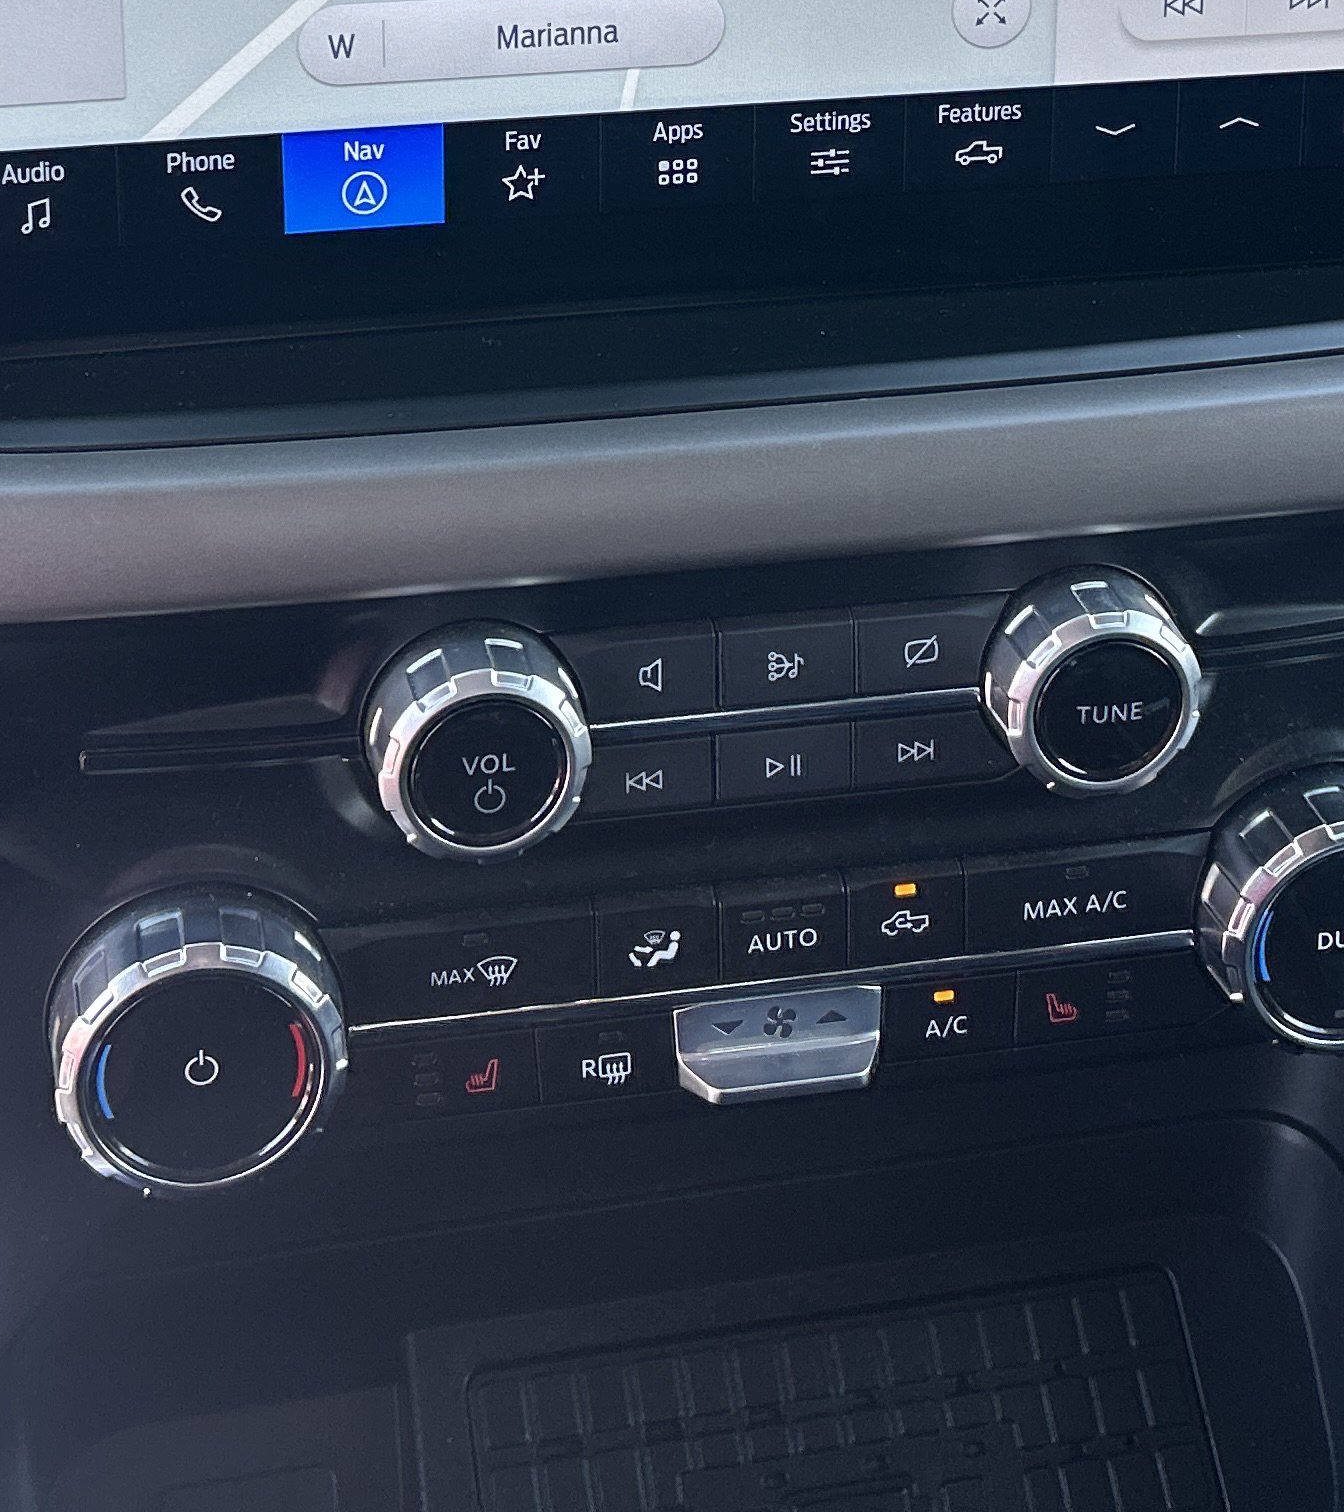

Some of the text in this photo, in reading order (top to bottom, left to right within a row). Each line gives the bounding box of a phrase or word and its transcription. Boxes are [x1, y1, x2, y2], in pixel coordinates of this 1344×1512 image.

[329, 33, 355, 59] W
[497, 19, 619, 50] Marianna
[790, 110, 871, 137] Settings
[937, 100, 1022, 125] Features
[504, 129, 542, 152] Fav
[653, 119, 704, 145] Apps
[166, 149, 236, 175] Phone
[343, 140, 385, 162] Nav
[1, 161, 65, 184] Audio
[1076, 700, 1144, 725] TUNE
[462, 753, 516, 776] VOL
[1023, 889, 1128, 921] MAX A/C
[748, 928, 818, 954] AUTO
[430, 966, 475, 988] MAX
[925, 1014, 968, 1039] A/C
[582, 1059, 595, 1079] R
